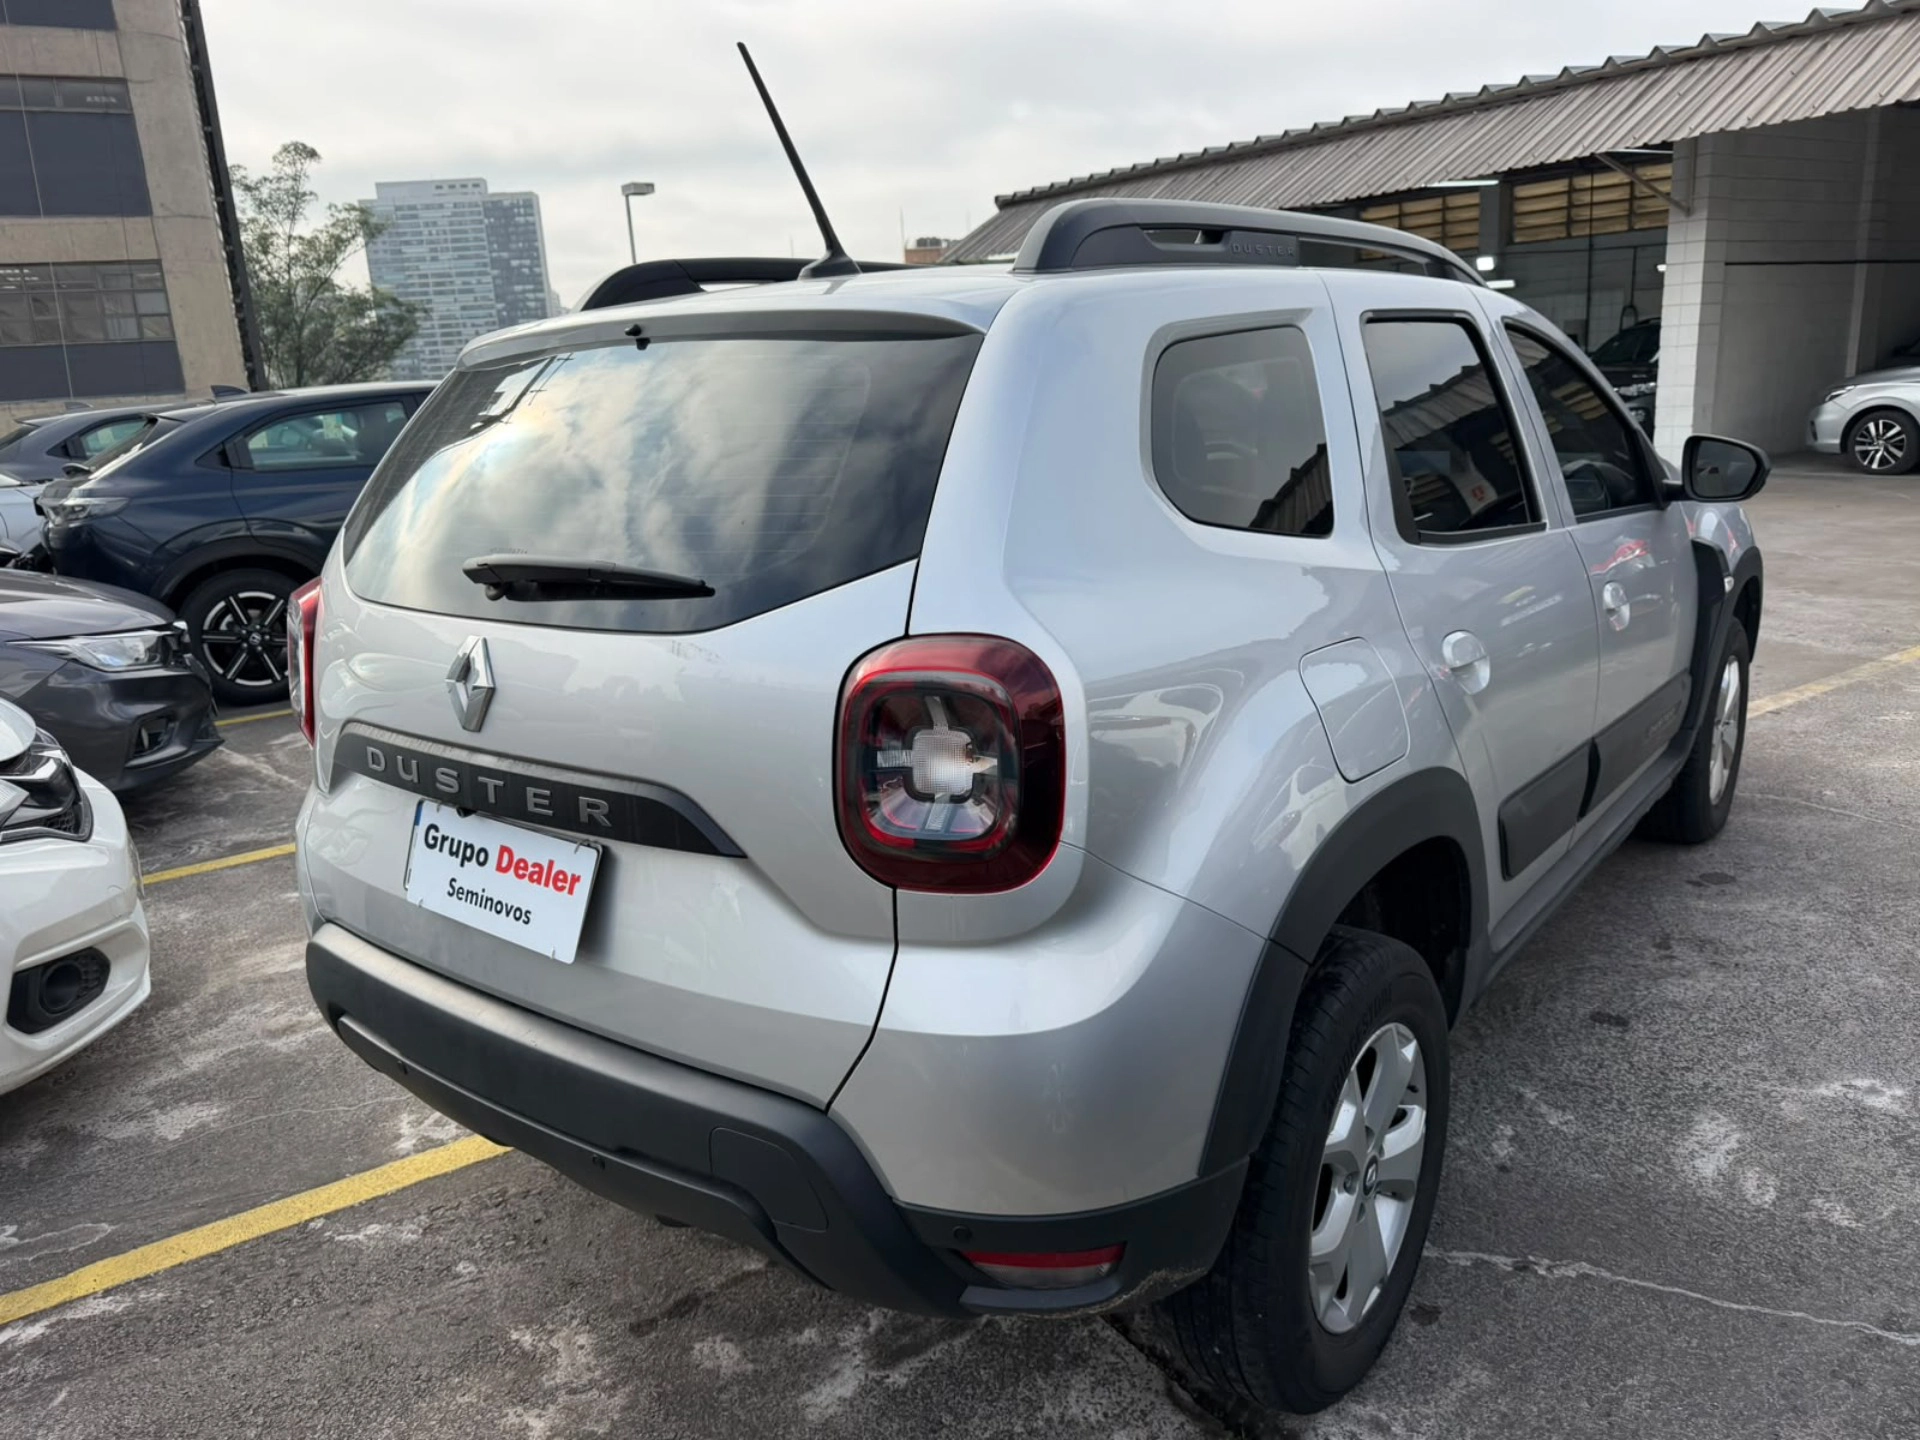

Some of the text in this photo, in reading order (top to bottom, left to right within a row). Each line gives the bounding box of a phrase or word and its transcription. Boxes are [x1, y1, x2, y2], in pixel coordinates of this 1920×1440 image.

[1231, 243, 1295, 257] DUSTER
[367, 746, 612, 827] DUSTER
[424, 823, 582, 896] Grupo Dealer
[447, 877, 532, 925] Seminovos
